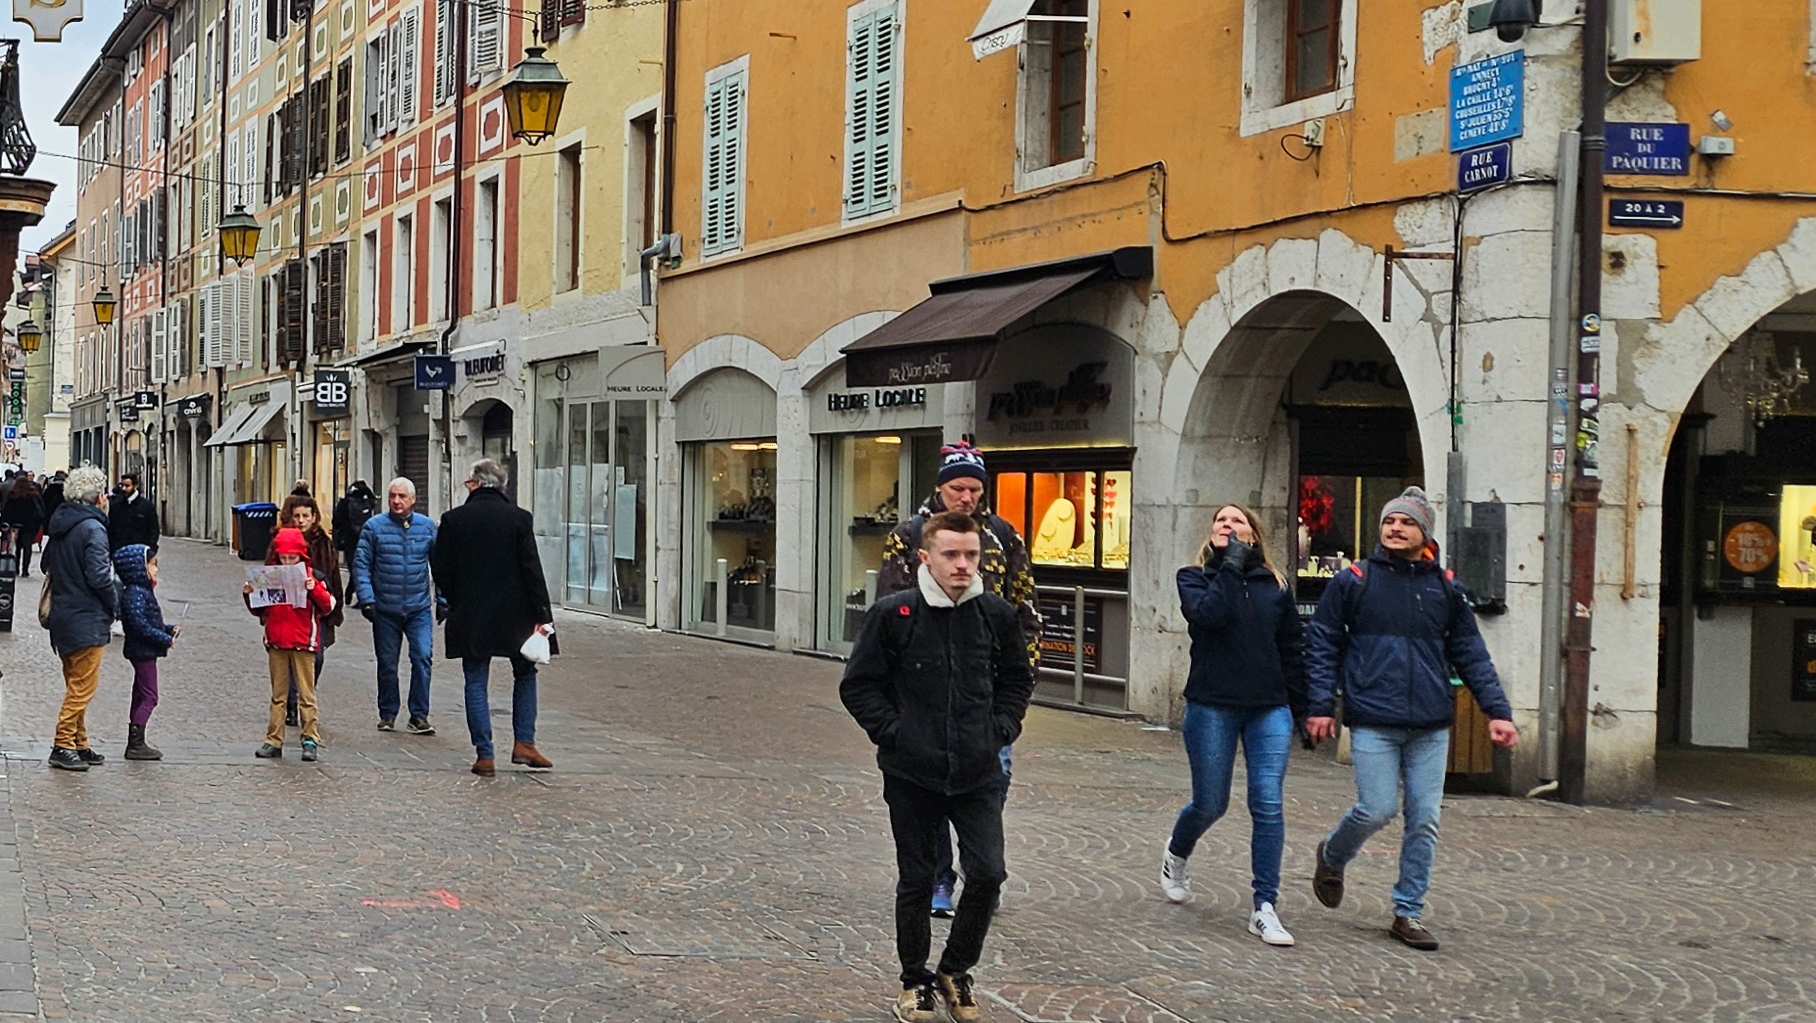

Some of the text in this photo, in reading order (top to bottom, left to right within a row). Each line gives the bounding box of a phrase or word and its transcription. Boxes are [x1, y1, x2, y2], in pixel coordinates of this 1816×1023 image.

[1471, 67, 1500, 82] ANNECY
[1630, 128, 1664, 141] RUE
[1637, 143, 1656, 153] DU
[1471, 150, 1494, 168] RUE
[1464, 165, 1499, 183] CARNOT
[1625, 203, 1641, 212] 20
[1657, 204, 1665, 213] 2
